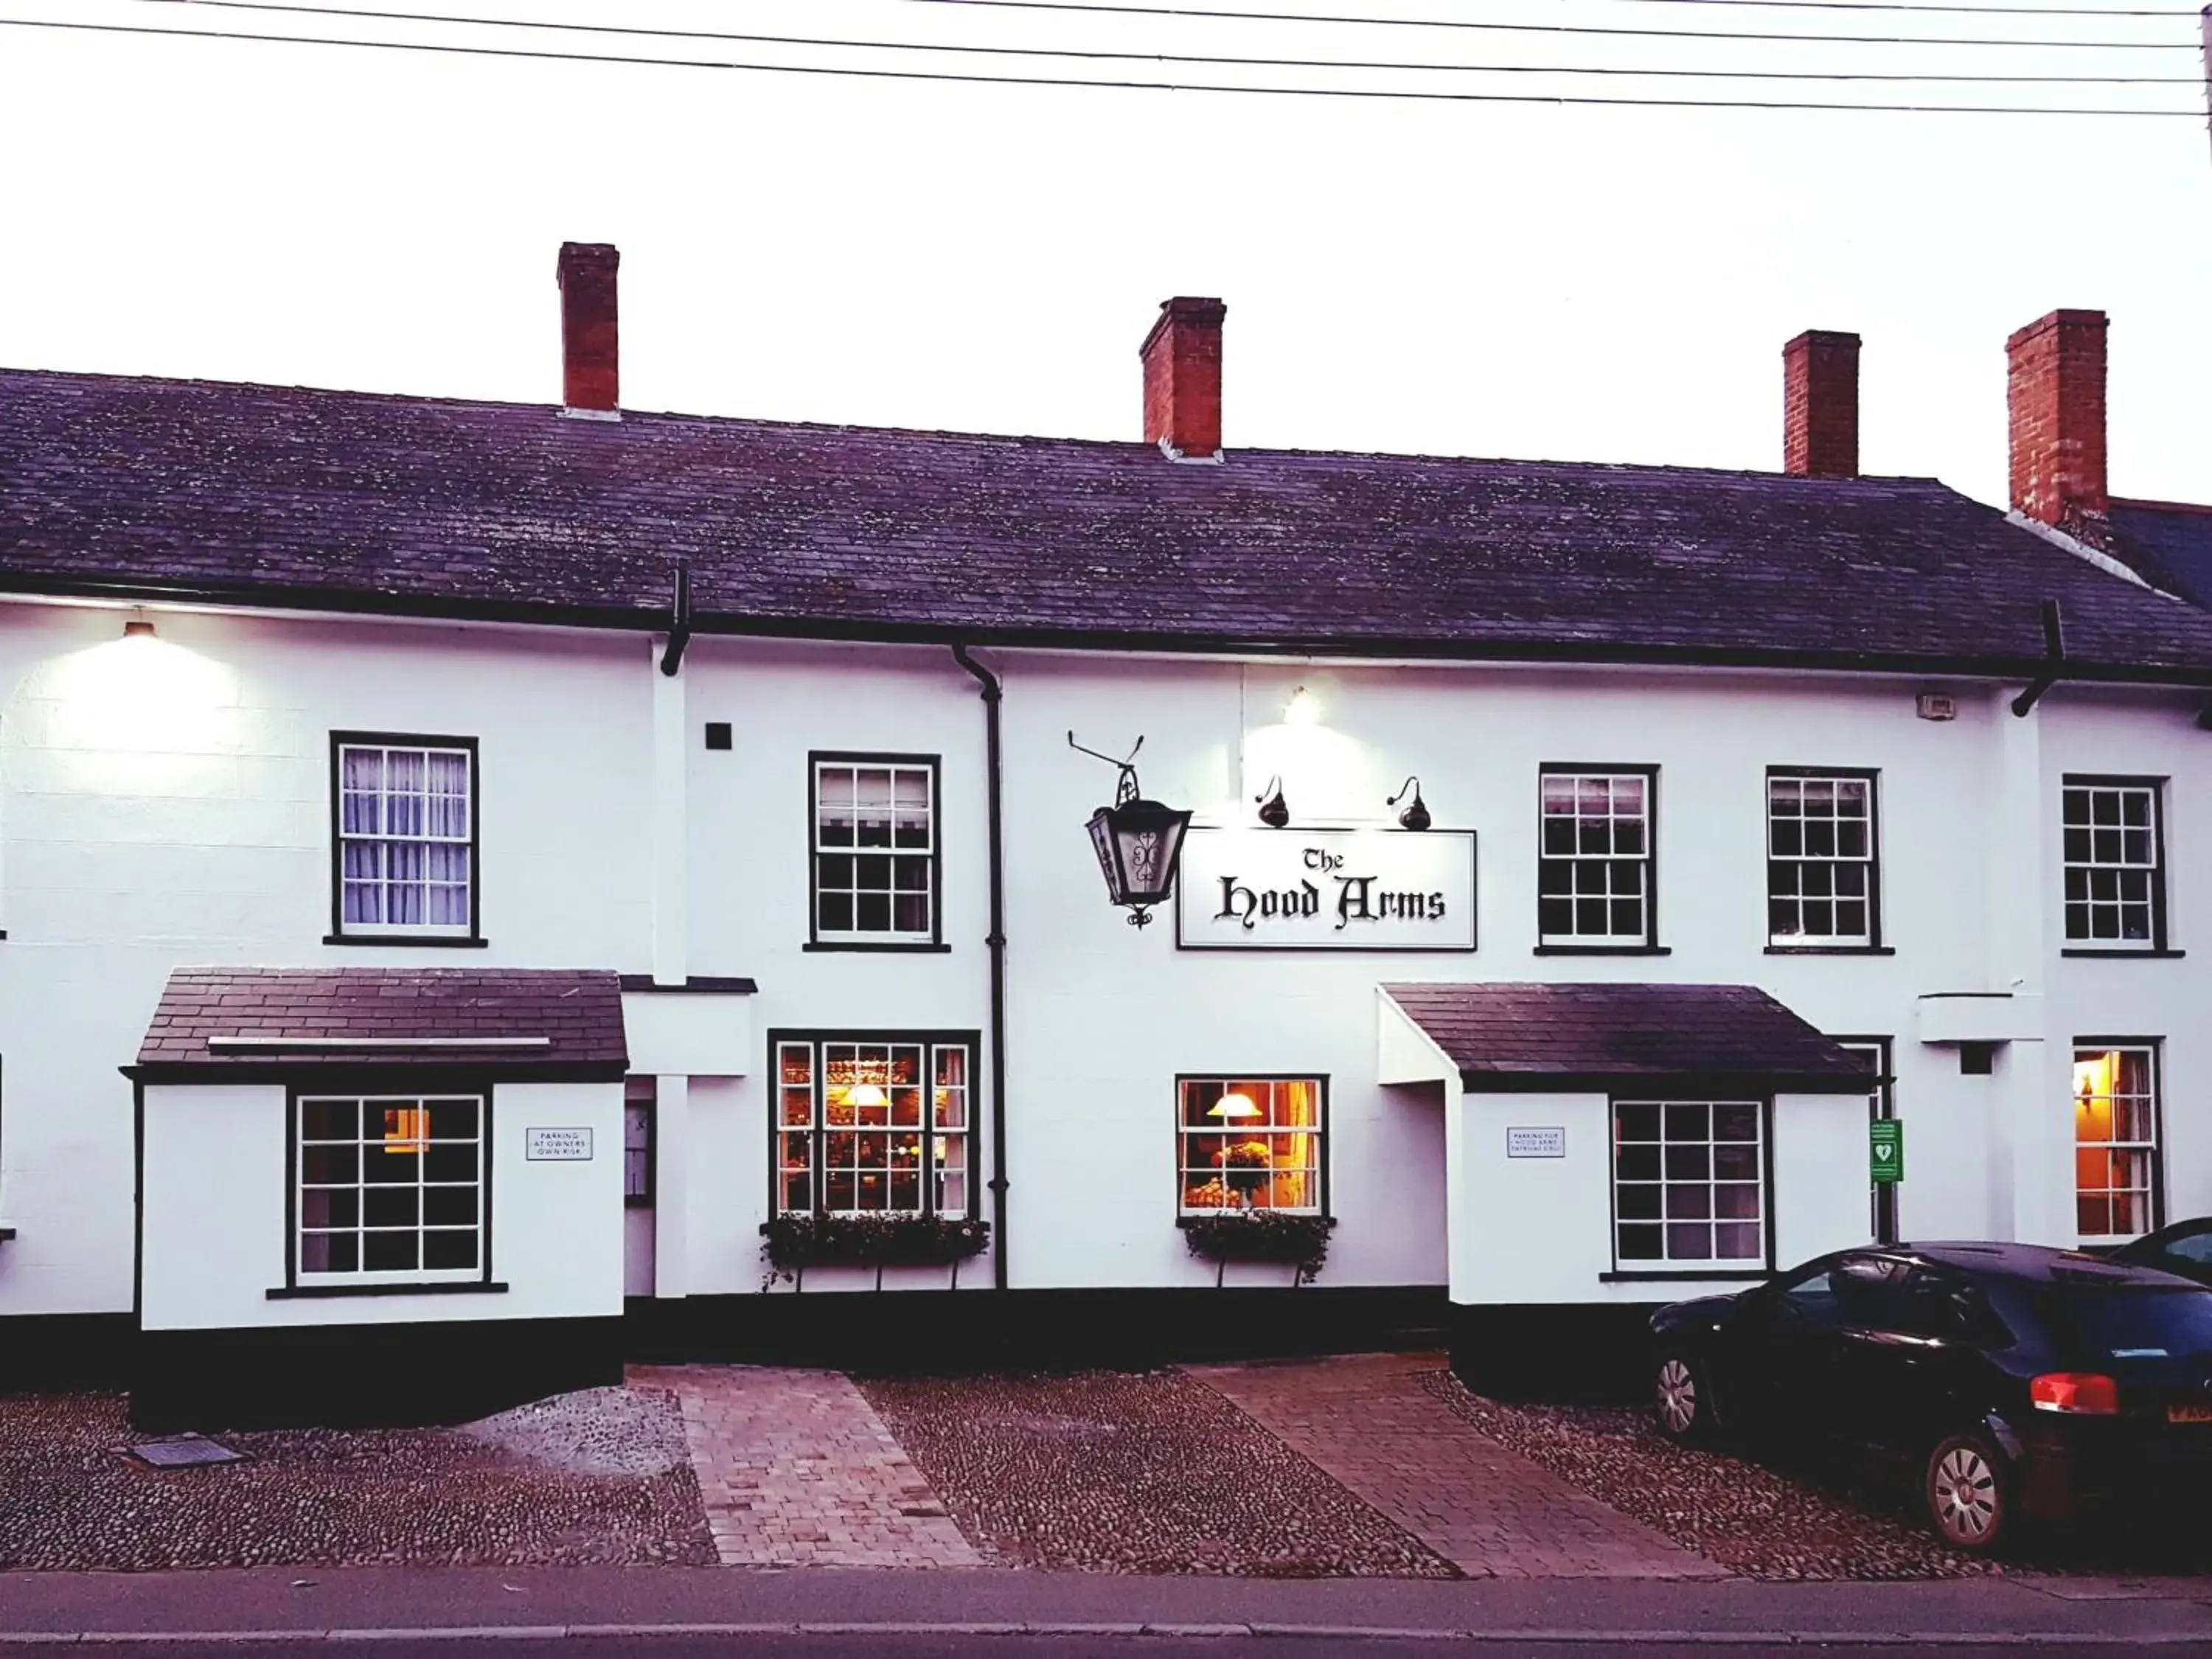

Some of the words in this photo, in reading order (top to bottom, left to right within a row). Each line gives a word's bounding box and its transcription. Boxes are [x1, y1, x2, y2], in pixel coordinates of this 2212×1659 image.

[1302, 847, 1345, 874] The
[1213, 875, 1320, 930] Hood
[1333, 875, 1447, 931] Arms
